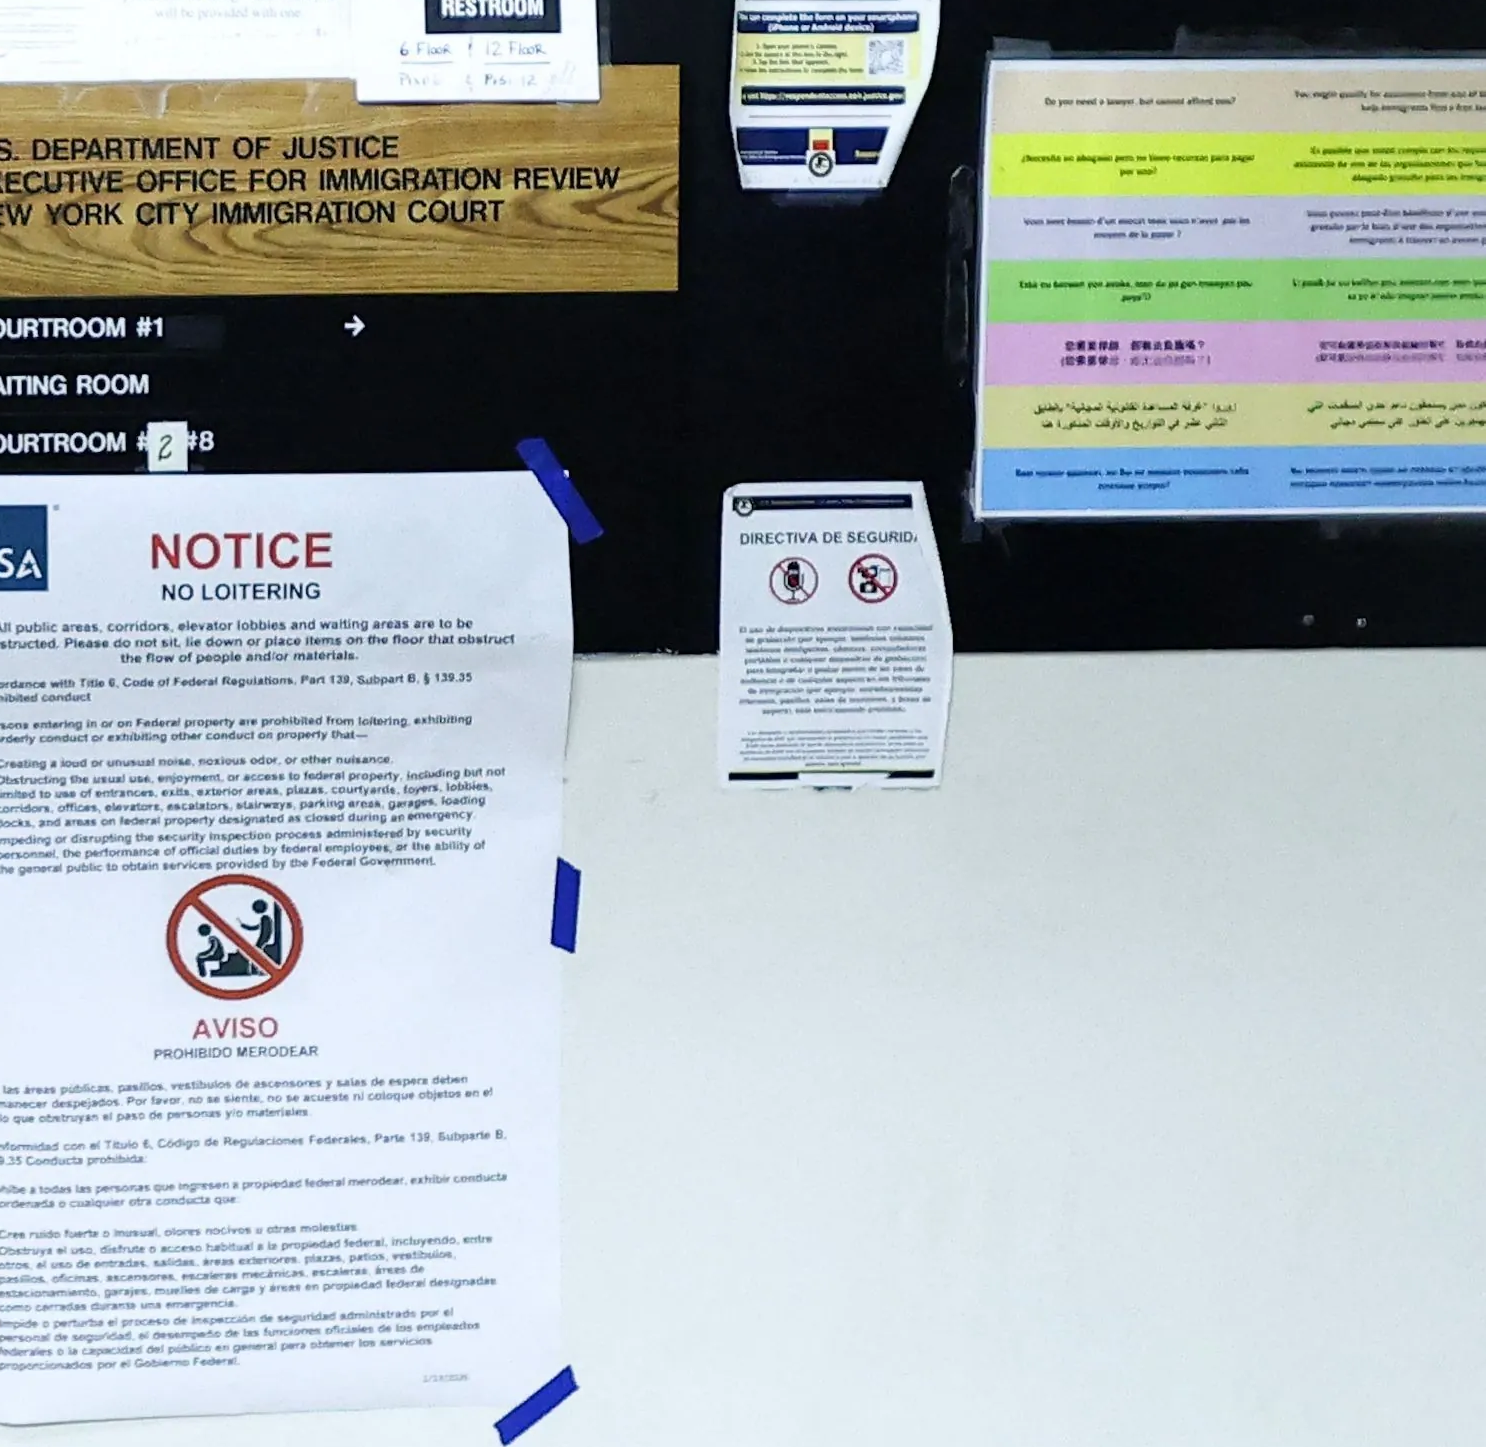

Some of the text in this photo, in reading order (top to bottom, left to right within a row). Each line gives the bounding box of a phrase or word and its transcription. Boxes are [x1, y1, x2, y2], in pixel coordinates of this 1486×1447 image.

[33, 137, 220, 161] DEPARTMENT
[233, 137, 271, 159] OF
[282, 135, 399, 160] JUSTICE
[136, 169, 237, 194] OFFICE
[249, 168, 306, 193] FOR
[319, 166, 508, 193] IMMIGRATION
[513, 165, 621, 192] REVIEW
[46, 202, 123, 226] YORK
[136, 201, 196, 227] CITY
[212, 200, 398, 227] IMMIGRATION
[407, 199, 505, 225] COURT
[136, 317, 162, 337] #1
[77, 374, 149, 395] ROOM
[740, 532, 817, 545] DIRECTIVA
[823, 532, 842, 543] DE
[152, 532, 332, 569] NOTICE
[162, 583, 320, 600] NO LOITERING
[16, 622, 57, 635] public
[178, 621, 232, 631] elevator
[237, 620, 286, 631] lobbies
[291, 620, 315, 630] and
[320, 619, 368, 632] waiting
[373, 620, 409, 629] areas
[414, 621, 434, 629] are
[439, 619, 452, 629] to
[457, 618, 472, 629] be
[193, 1017, 278, 1039] AVISO
[154, 1046, 318, 1060] PROHIBIDO MERODEAR
